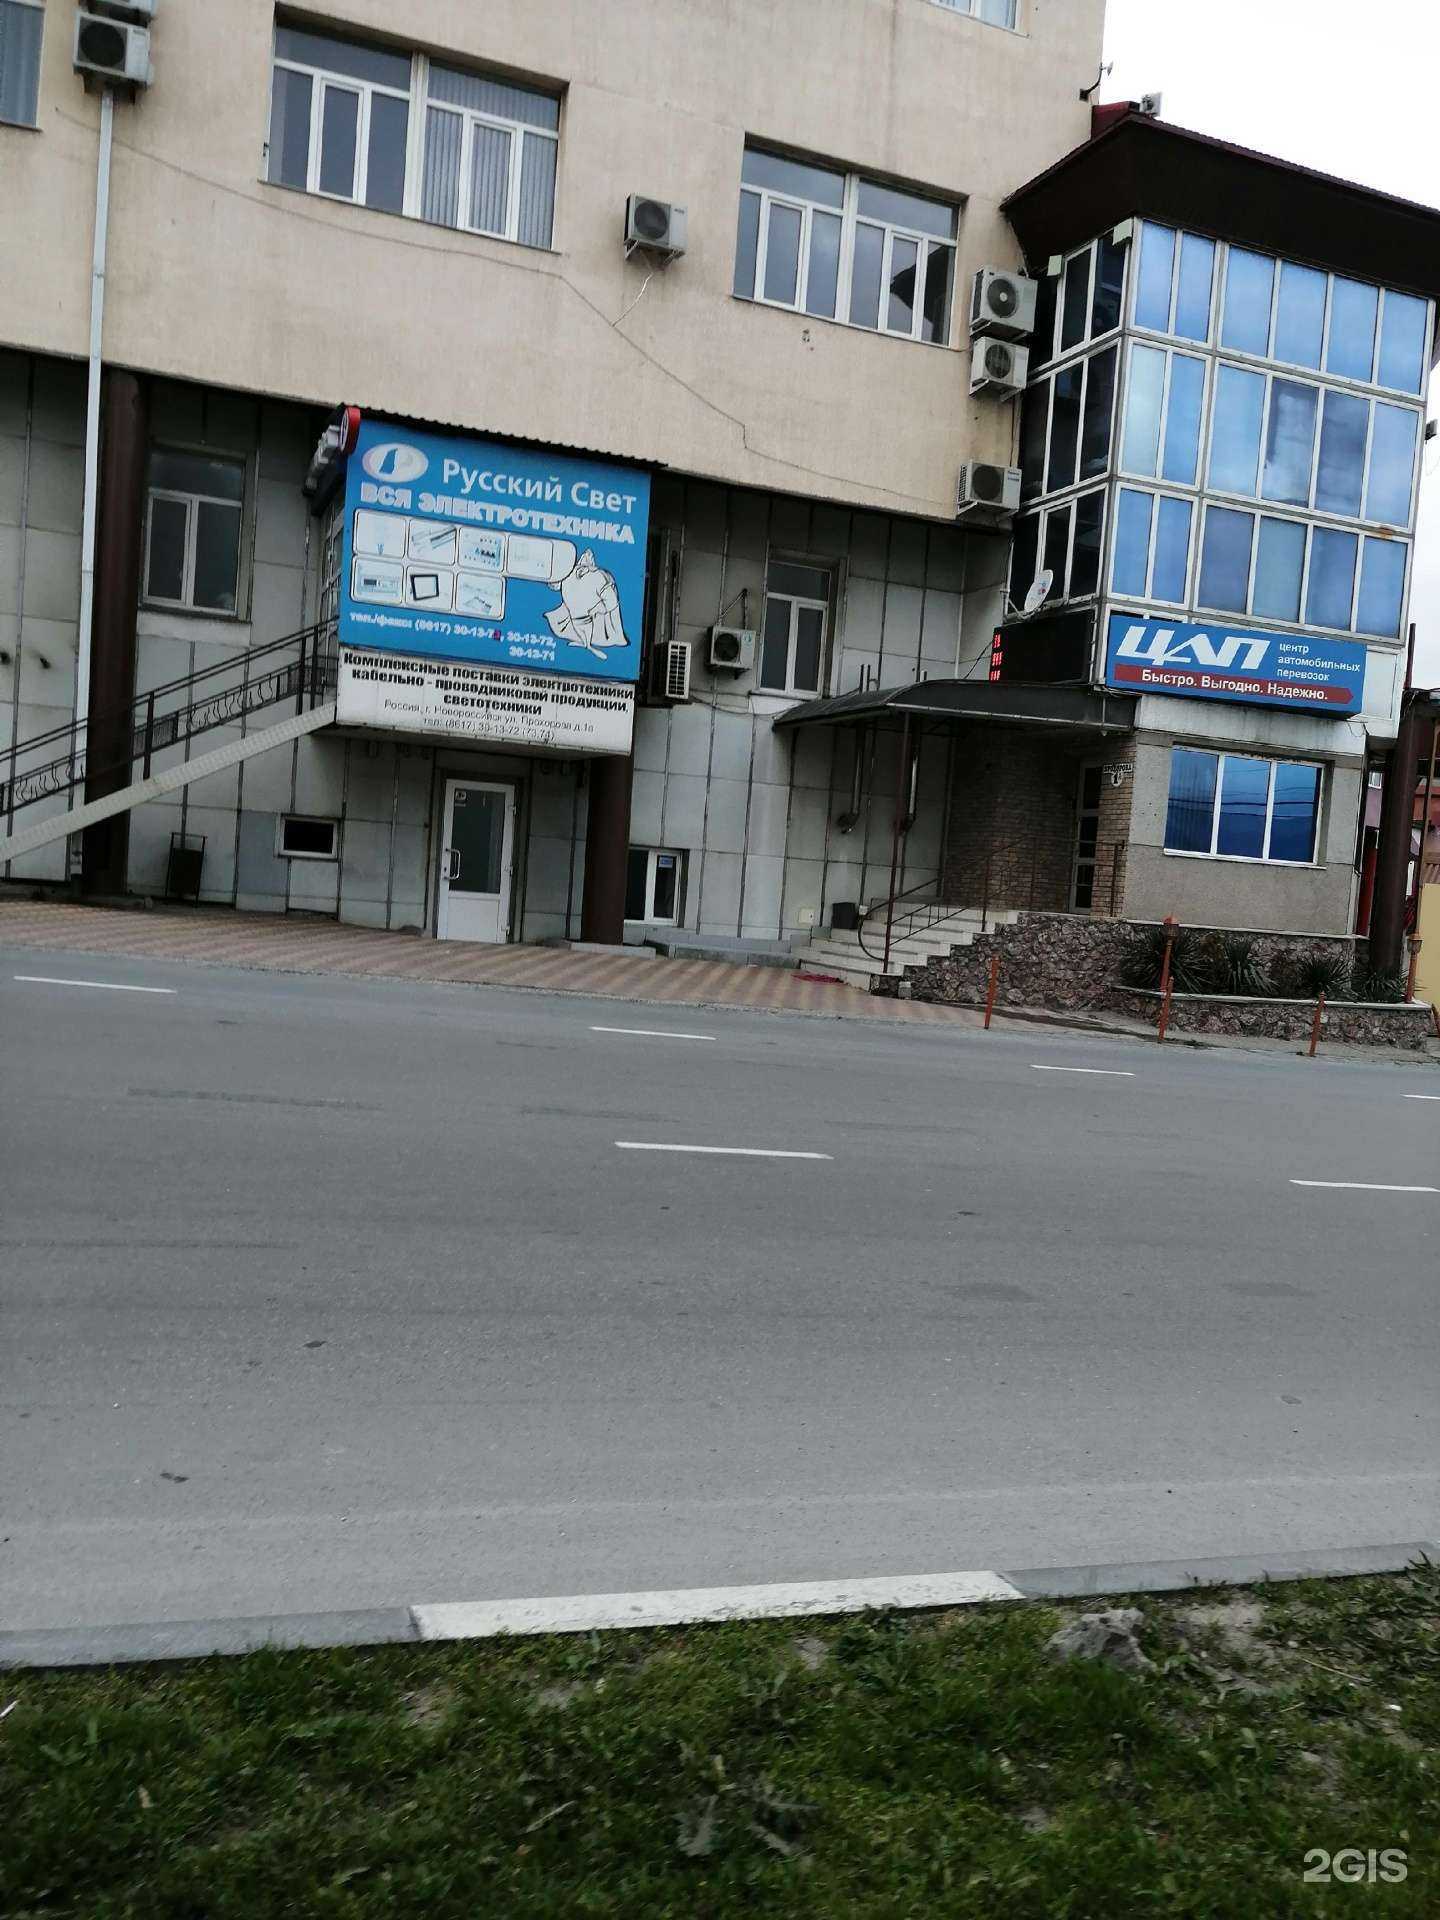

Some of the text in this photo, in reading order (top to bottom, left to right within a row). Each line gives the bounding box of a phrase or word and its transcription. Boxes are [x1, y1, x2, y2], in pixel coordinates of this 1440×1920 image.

[443, 458, 637, 514] Русский Свет
[360, 481, 635, 544] ВСЯ ЭЛЕКТРОТЕХНИКА
[1277, 655, 1361, 673] автомобильных
[1279, 643, 1309, 655] центр
[344, 652, 633, 700] Комплексные поставки электротехники
[352, 668, 424, 687] кабельно
[435, 678, 548, 702] проводниковой
[1142, 669, 1329, 701] Быстро. Выгодно. Надежно.
[1277, 668, 1330, 682] перевозок
[443, 694, 542, 716] светотехники
